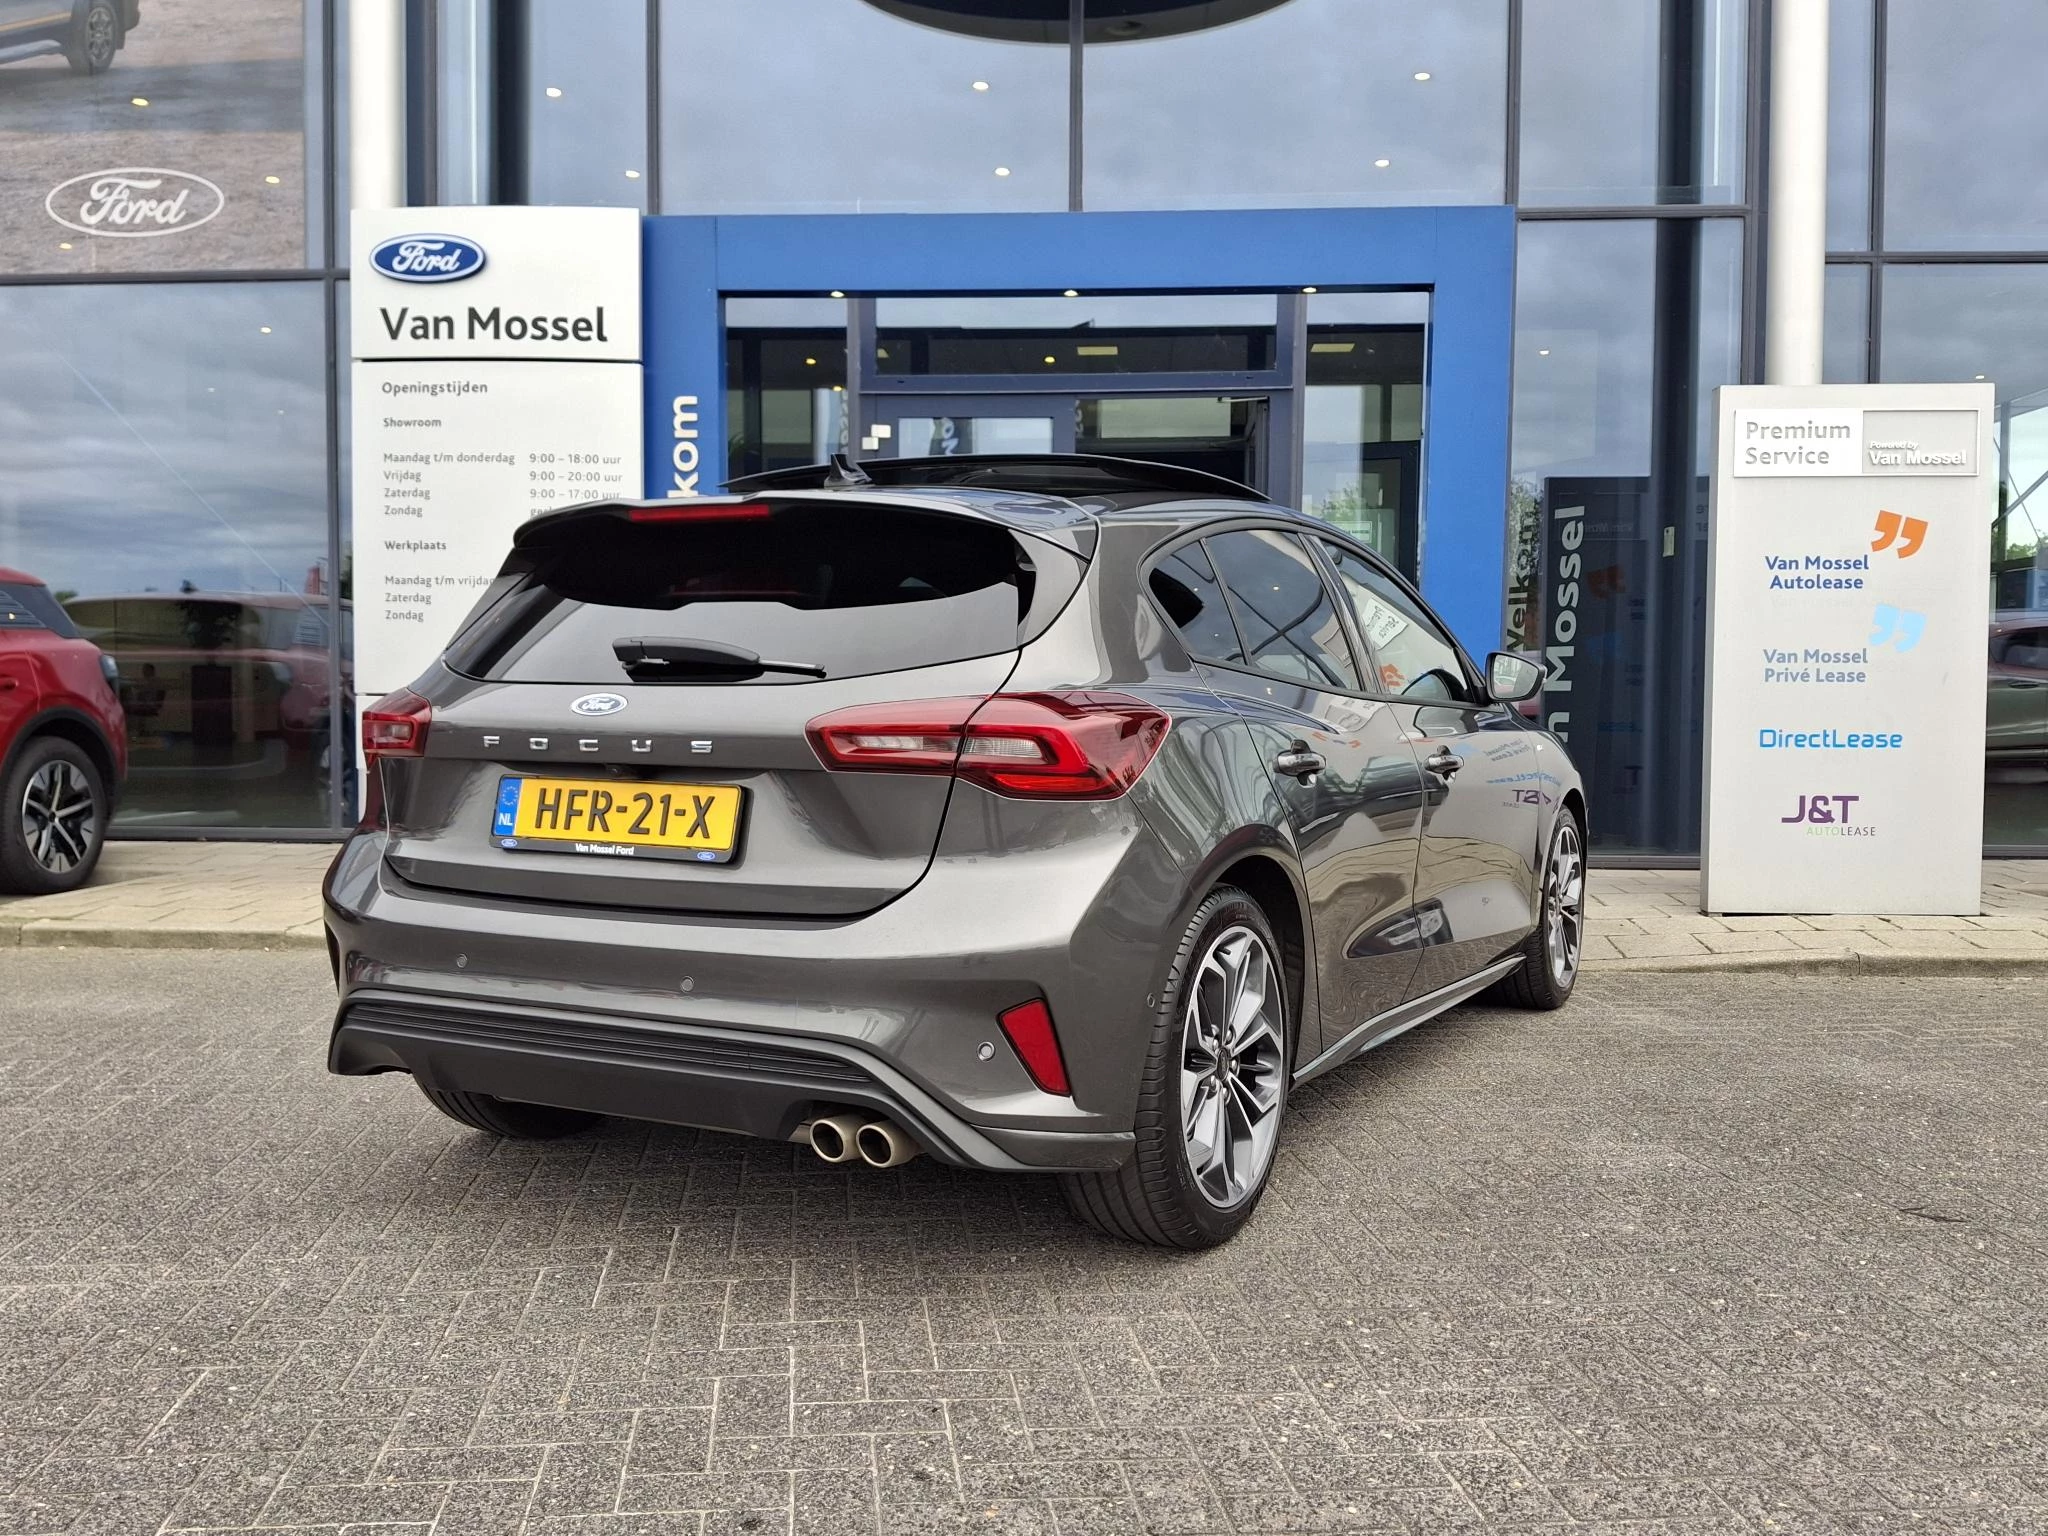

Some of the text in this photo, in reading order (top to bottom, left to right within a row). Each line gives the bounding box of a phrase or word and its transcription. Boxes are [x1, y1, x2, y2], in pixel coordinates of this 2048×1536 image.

[80, 177, 189, 224] Ford
[392, 241, 462, 272] Ford
[380, 306, 608, 342] Van Mossel
[382, 381, 488, 398] Openingstijden
[383, 417, 442, 428] Showroom
[1746, 420, 1851, 440] Premium
[384, 453, 430, 466] Maandag
[434, 452, 454, 464] t/m
[457, 452, 516, 466] donderdag
[529, 453, 555, 464] 9:00
[568, 453, 600, 465] 18:00
[602, 456, 622, 465] uur
[1745, 447, 1830, 465] Service
[1870, 448, 1967, 466] Van Mossel
[384, 470, 422, 483] Vrijdag
[529, 471, 555, 482] 9:00
[567, 471, 601, 482] 20:00
[603, 474, 622, 483] uur
[384, 488, 431, 501] Zaterdag
[529, 488, 555, 499] 9:00
[568, 489, 599, 500] 17:00
[384, 505, 423, 518] Zondag
[384, 539, 447, 553] Werkplaats
[1764, 554, 1870, 571] Van Mossel
[385, 575, 432, 588] Maandag
[435, 575, 455, 586] t/m
[1769, 574, 1864, 590] Autolease
[384, 592, 432, 605] Zaterdag
[1543, 505, 1585, 692] Mossel
[385, 609, 424, 623] Zondag
[1763, 648, 1869, 664] Van Mossel
[1764, 667, 1867, 683] Privé Lease
[483, 735, 713, 753] FOCUS
[1759, 729, 1903, 749] DirectLease
[498, 788, 715, 839] NL HFR-21-X
[1781, 795, 1860, 824] J&T
[1806, 826, 1876, 837] AUTOLEASE
[575, 843, 635, 856] Van Mossel Ford
